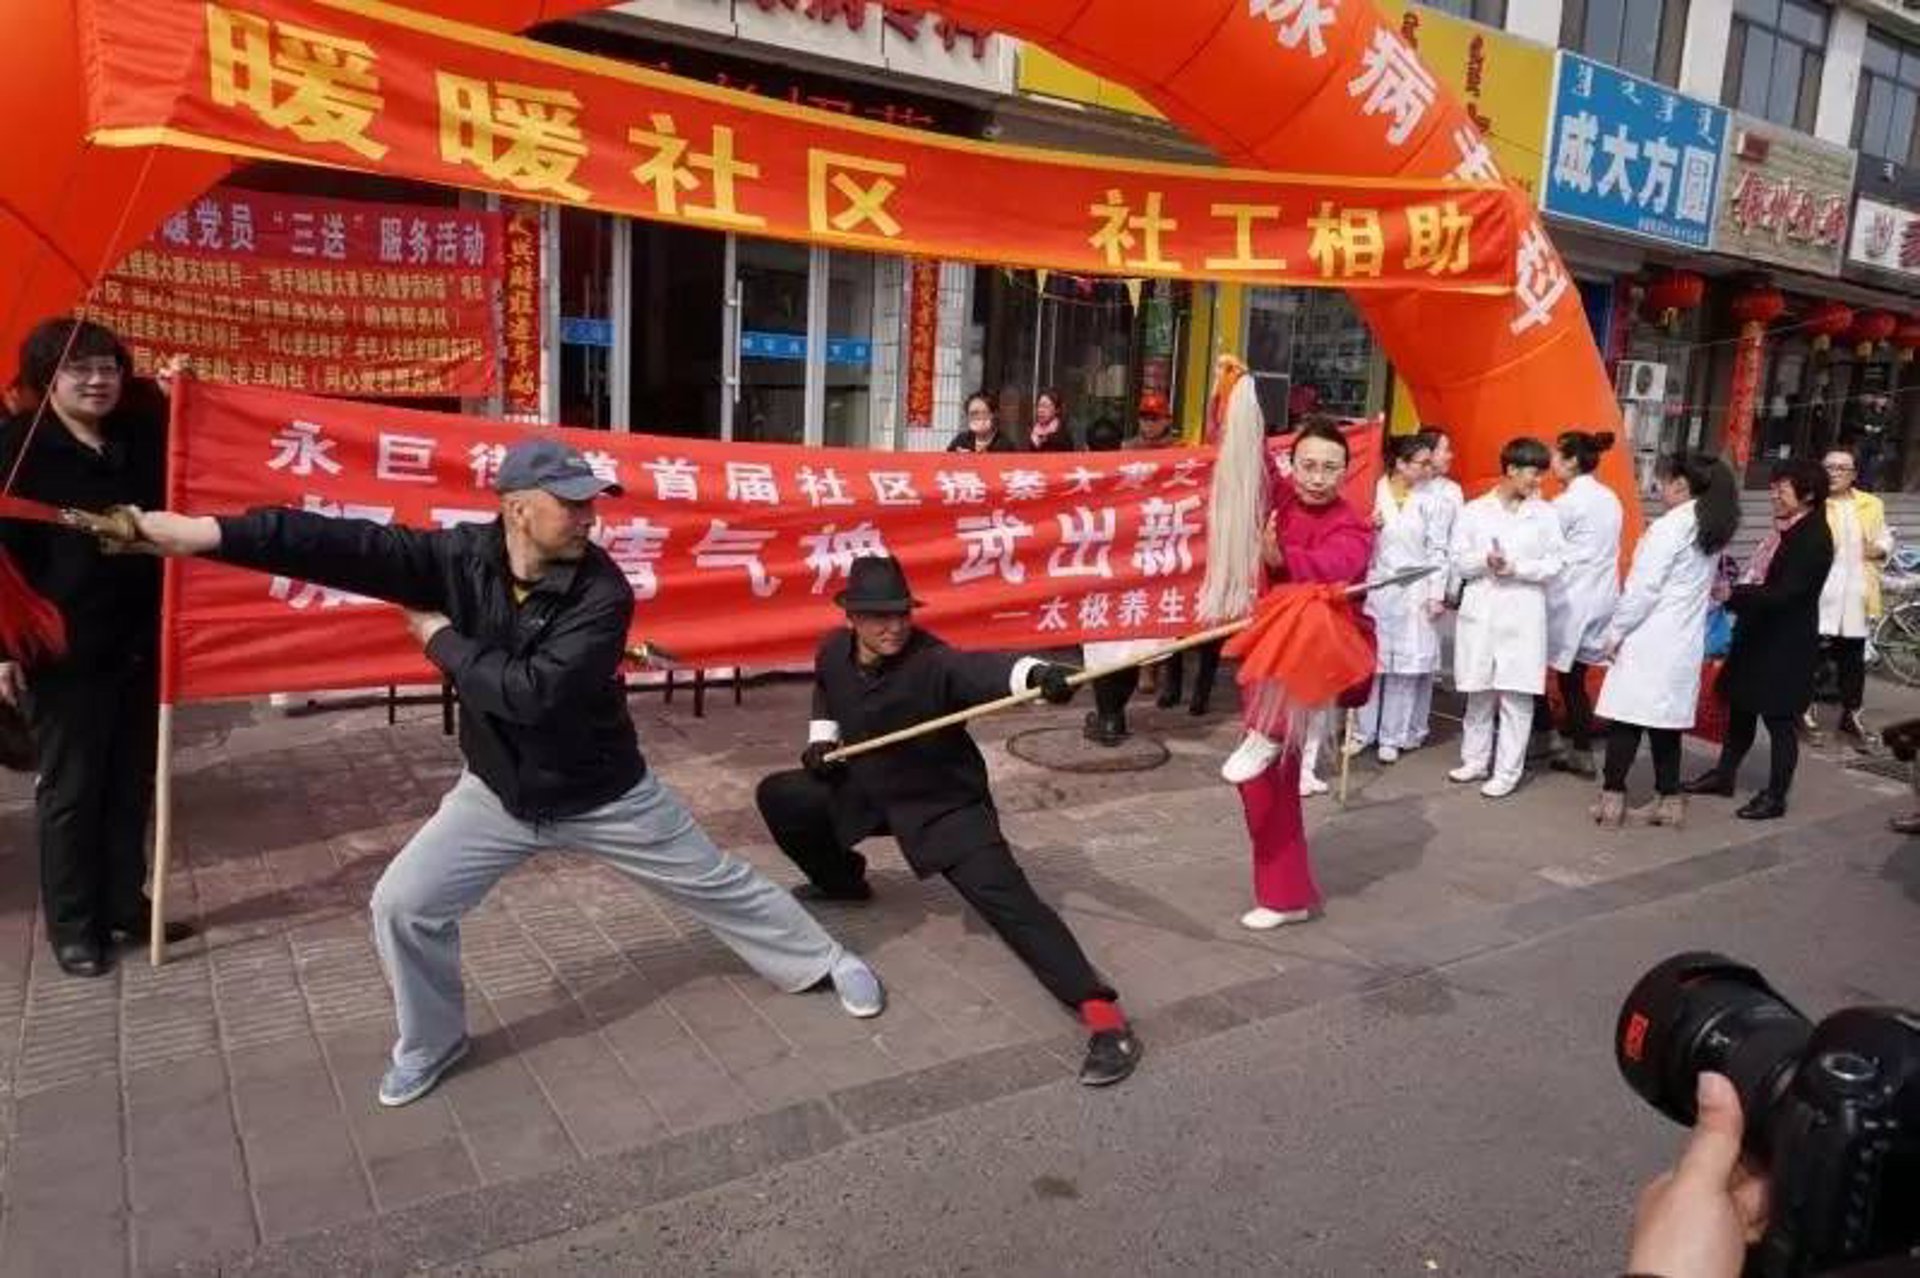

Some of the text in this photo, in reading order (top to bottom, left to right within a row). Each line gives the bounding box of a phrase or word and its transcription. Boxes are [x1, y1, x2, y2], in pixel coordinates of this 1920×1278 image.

[207, 8, 908, 237] 暖暖社区
[1088, 188, 1474, 277] 社工相助
[950, 494, 1202, 585] 武出新
